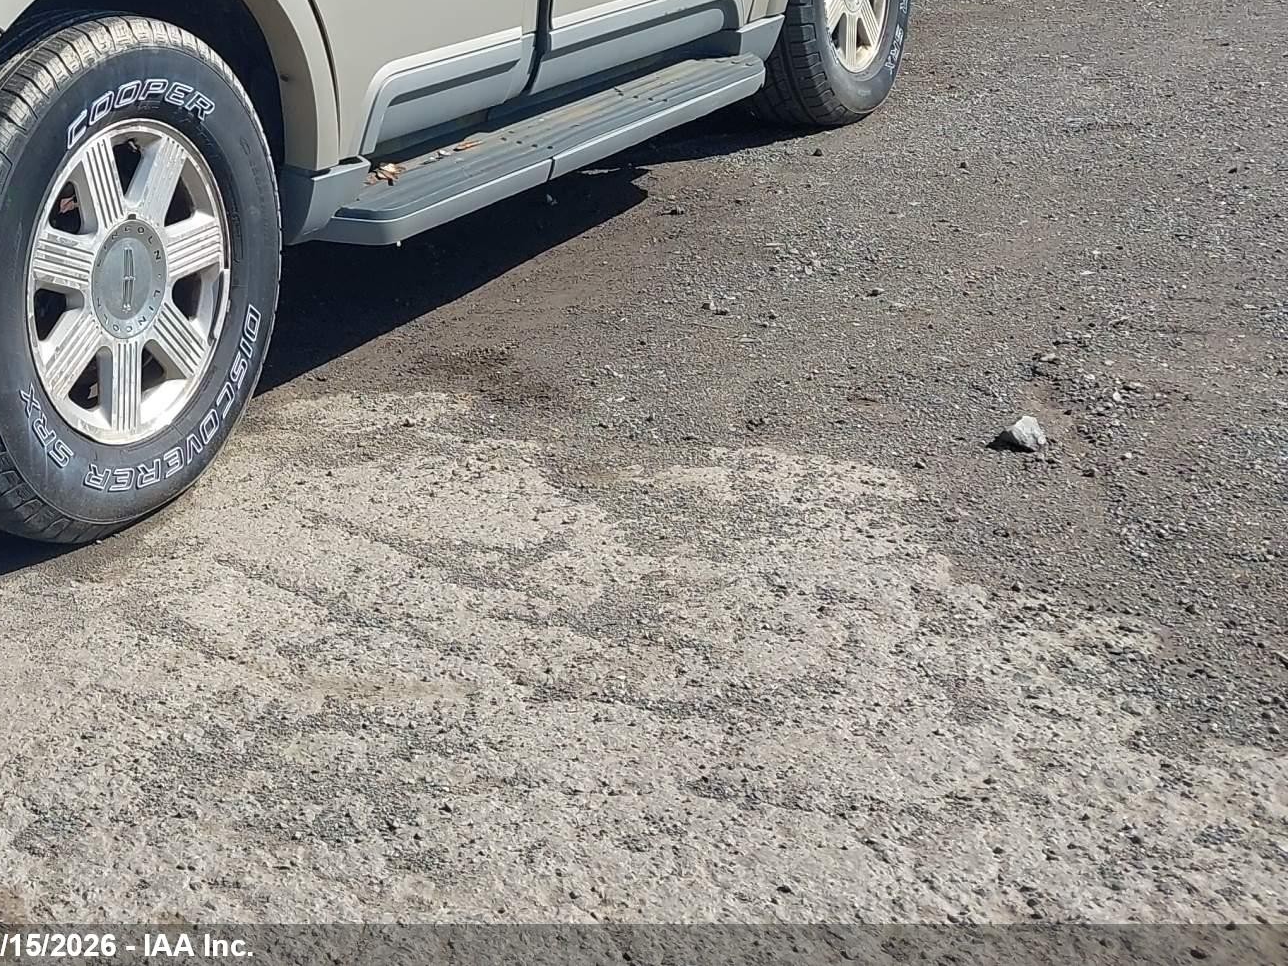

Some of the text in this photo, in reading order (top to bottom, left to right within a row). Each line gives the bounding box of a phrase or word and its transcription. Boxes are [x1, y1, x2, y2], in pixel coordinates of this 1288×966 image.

[67, 79, 216, 150] COOPER
[19, 303, 262, 492] DISCOVERER SRX
